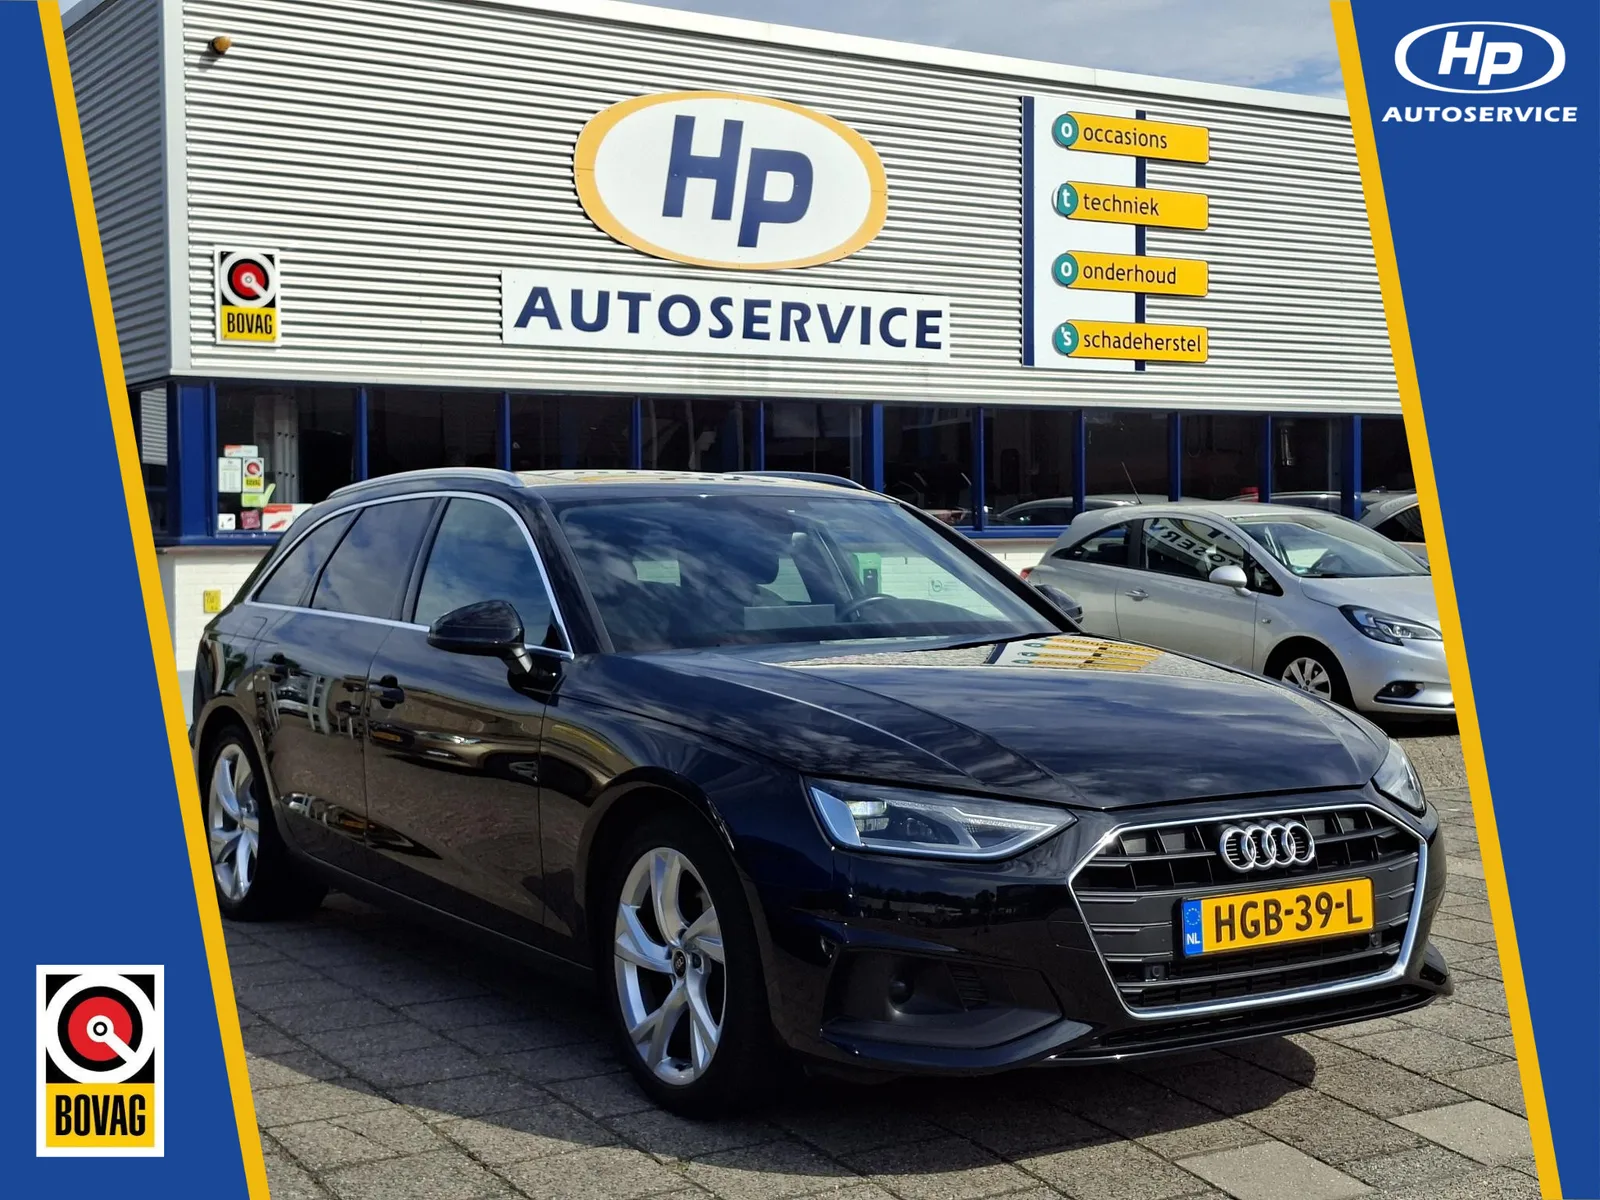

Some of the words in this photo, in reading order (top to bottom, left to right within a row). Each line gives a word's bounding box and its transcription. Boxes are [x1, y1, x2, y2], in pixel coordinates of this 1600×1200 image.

[1083, 126, 1168, 149] occasions
[662, 114, 814, 248] Hp
[1083, 193, 1160, 216] techniek
[1083, 262, 1176, 285] onderhoud
[227, 312, 272, 335] BOVAG
[513, 286, 943, 350] AUTOSERVICE
[1083, 330, 1201, 352] schadeherstel
[1214, 888, 1363, 943] HGB-39-L
[1186, 933, 1201, 945] NL
